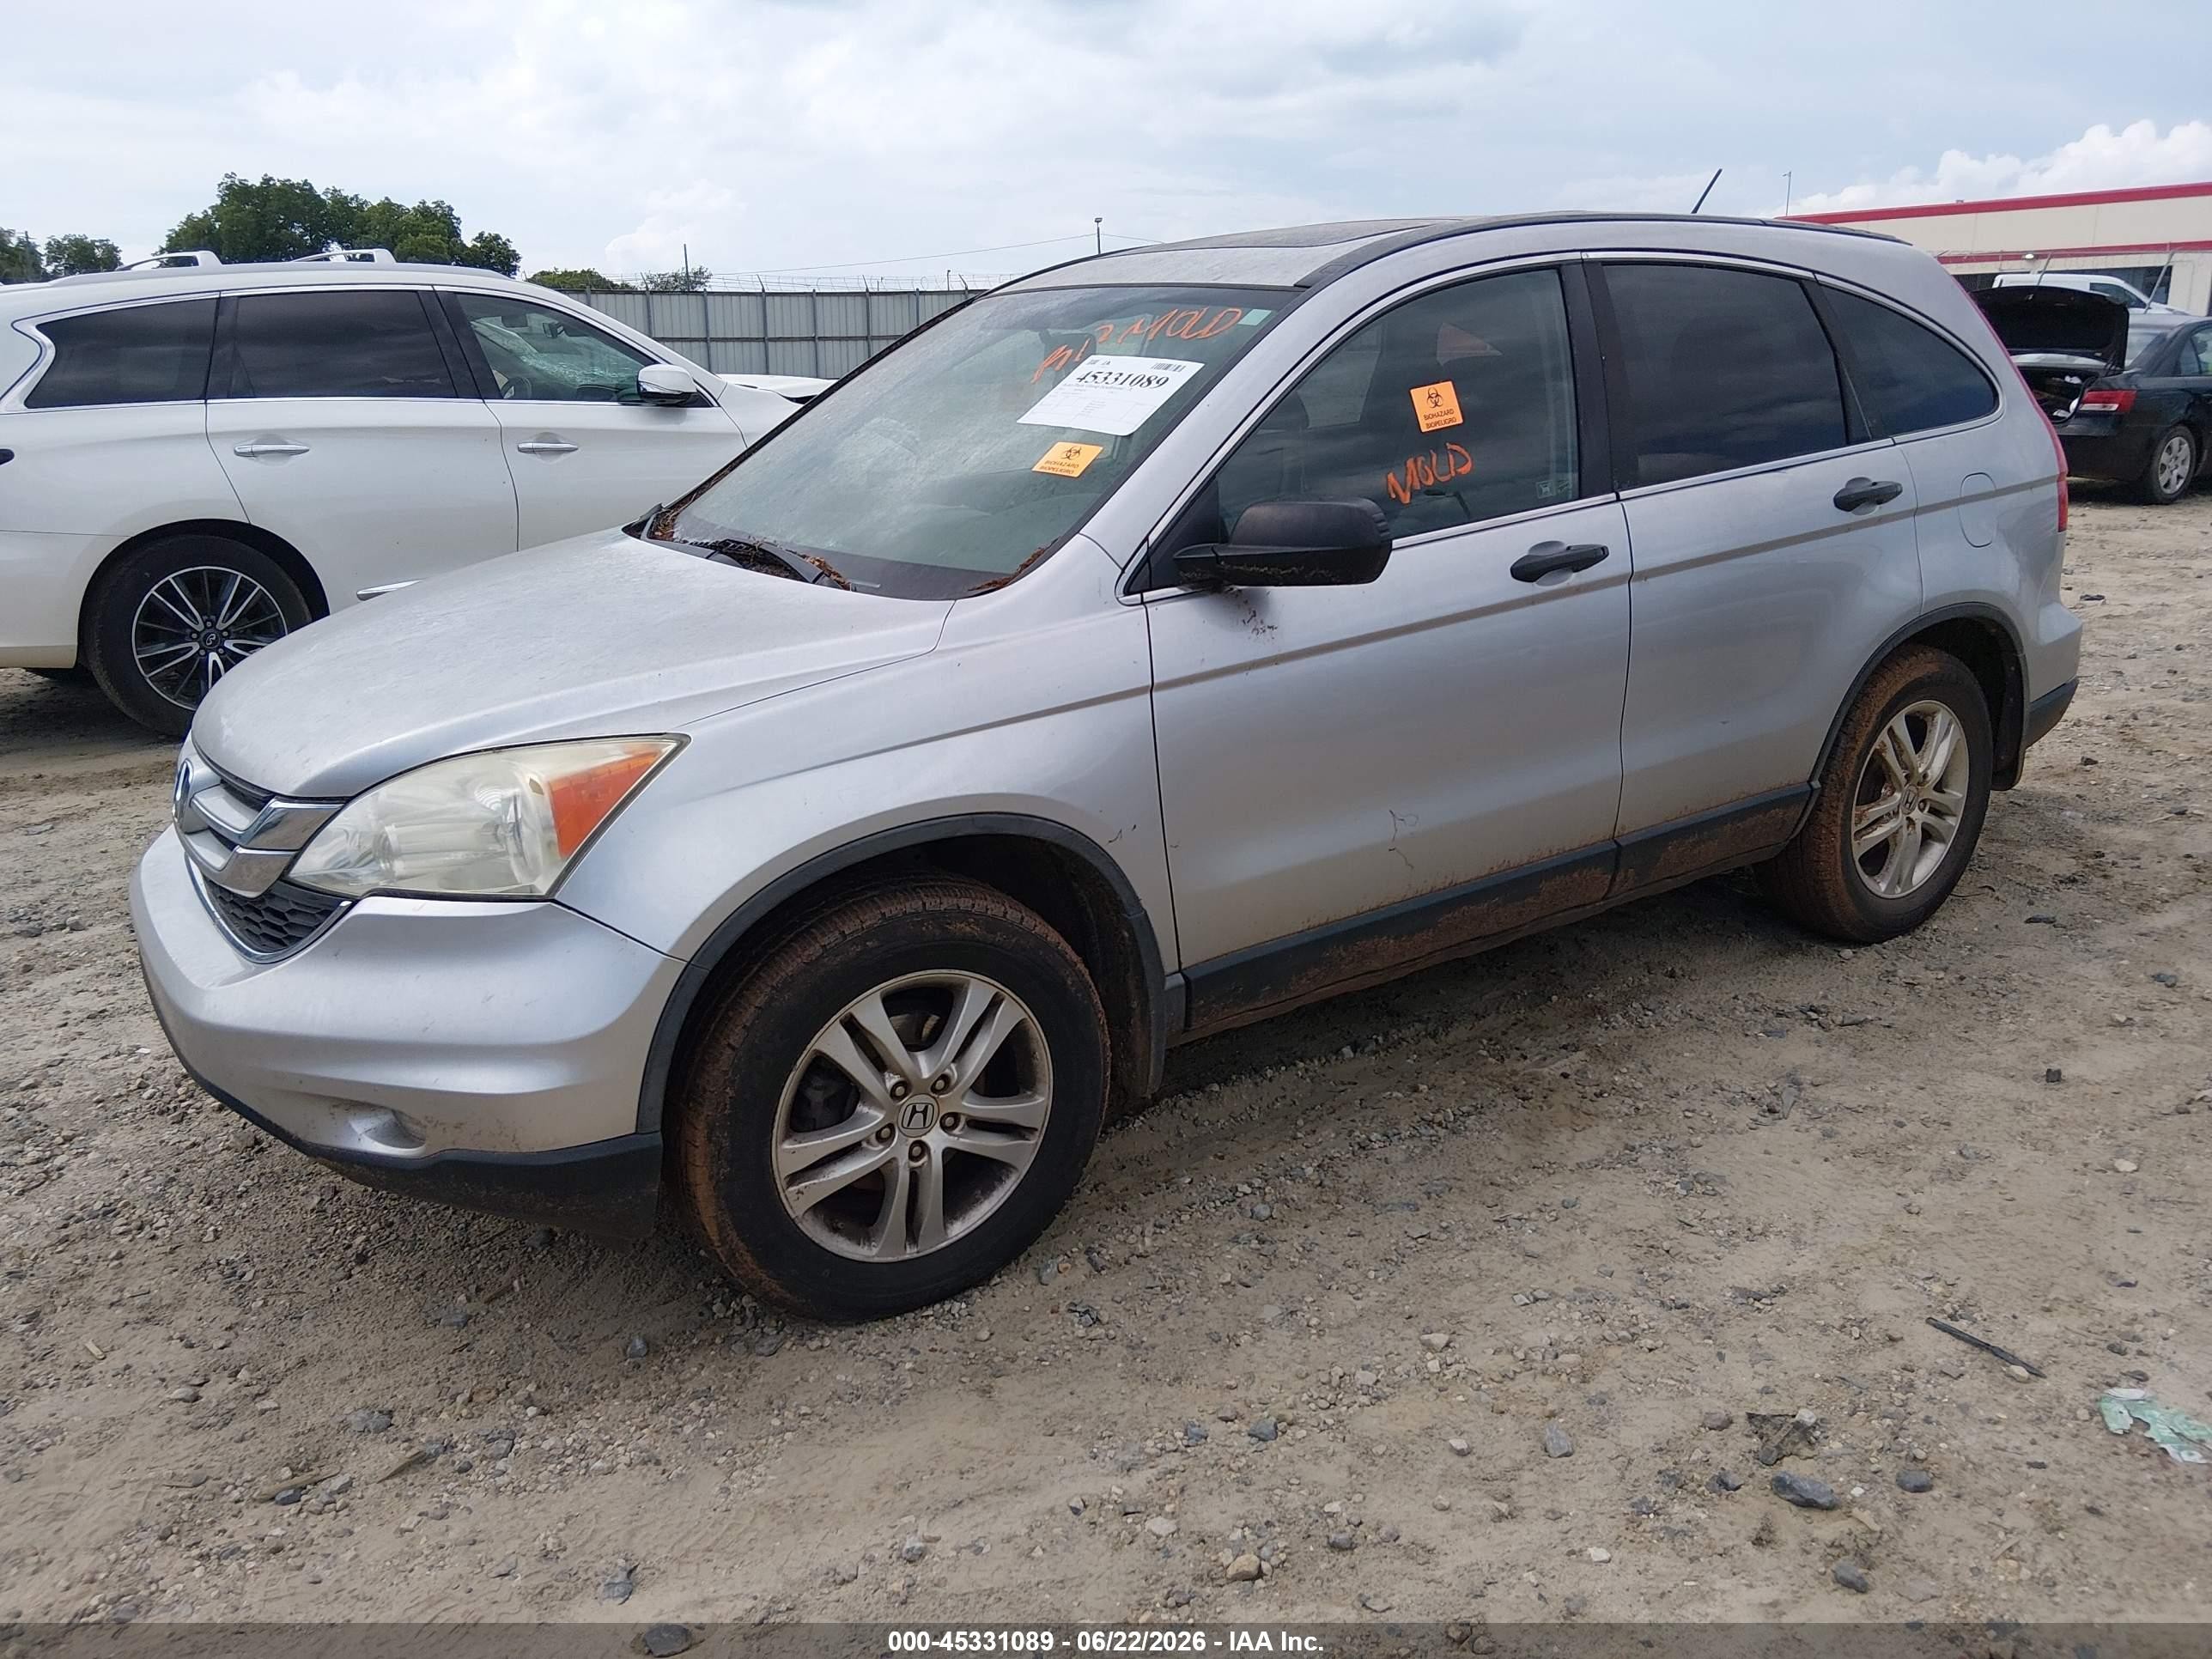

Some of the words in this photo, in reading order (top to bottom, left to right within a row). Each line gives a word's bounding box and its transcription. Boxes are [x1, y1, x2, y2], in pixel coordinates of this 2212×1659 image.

[1076, 370, 1170, 389] 45331089
[1423, 409, 1455, 421] BIOHAZARD
[1044, 460, 1079, 469] BIOHAZARD
[1387, 442, 1474, 505] MOLD
